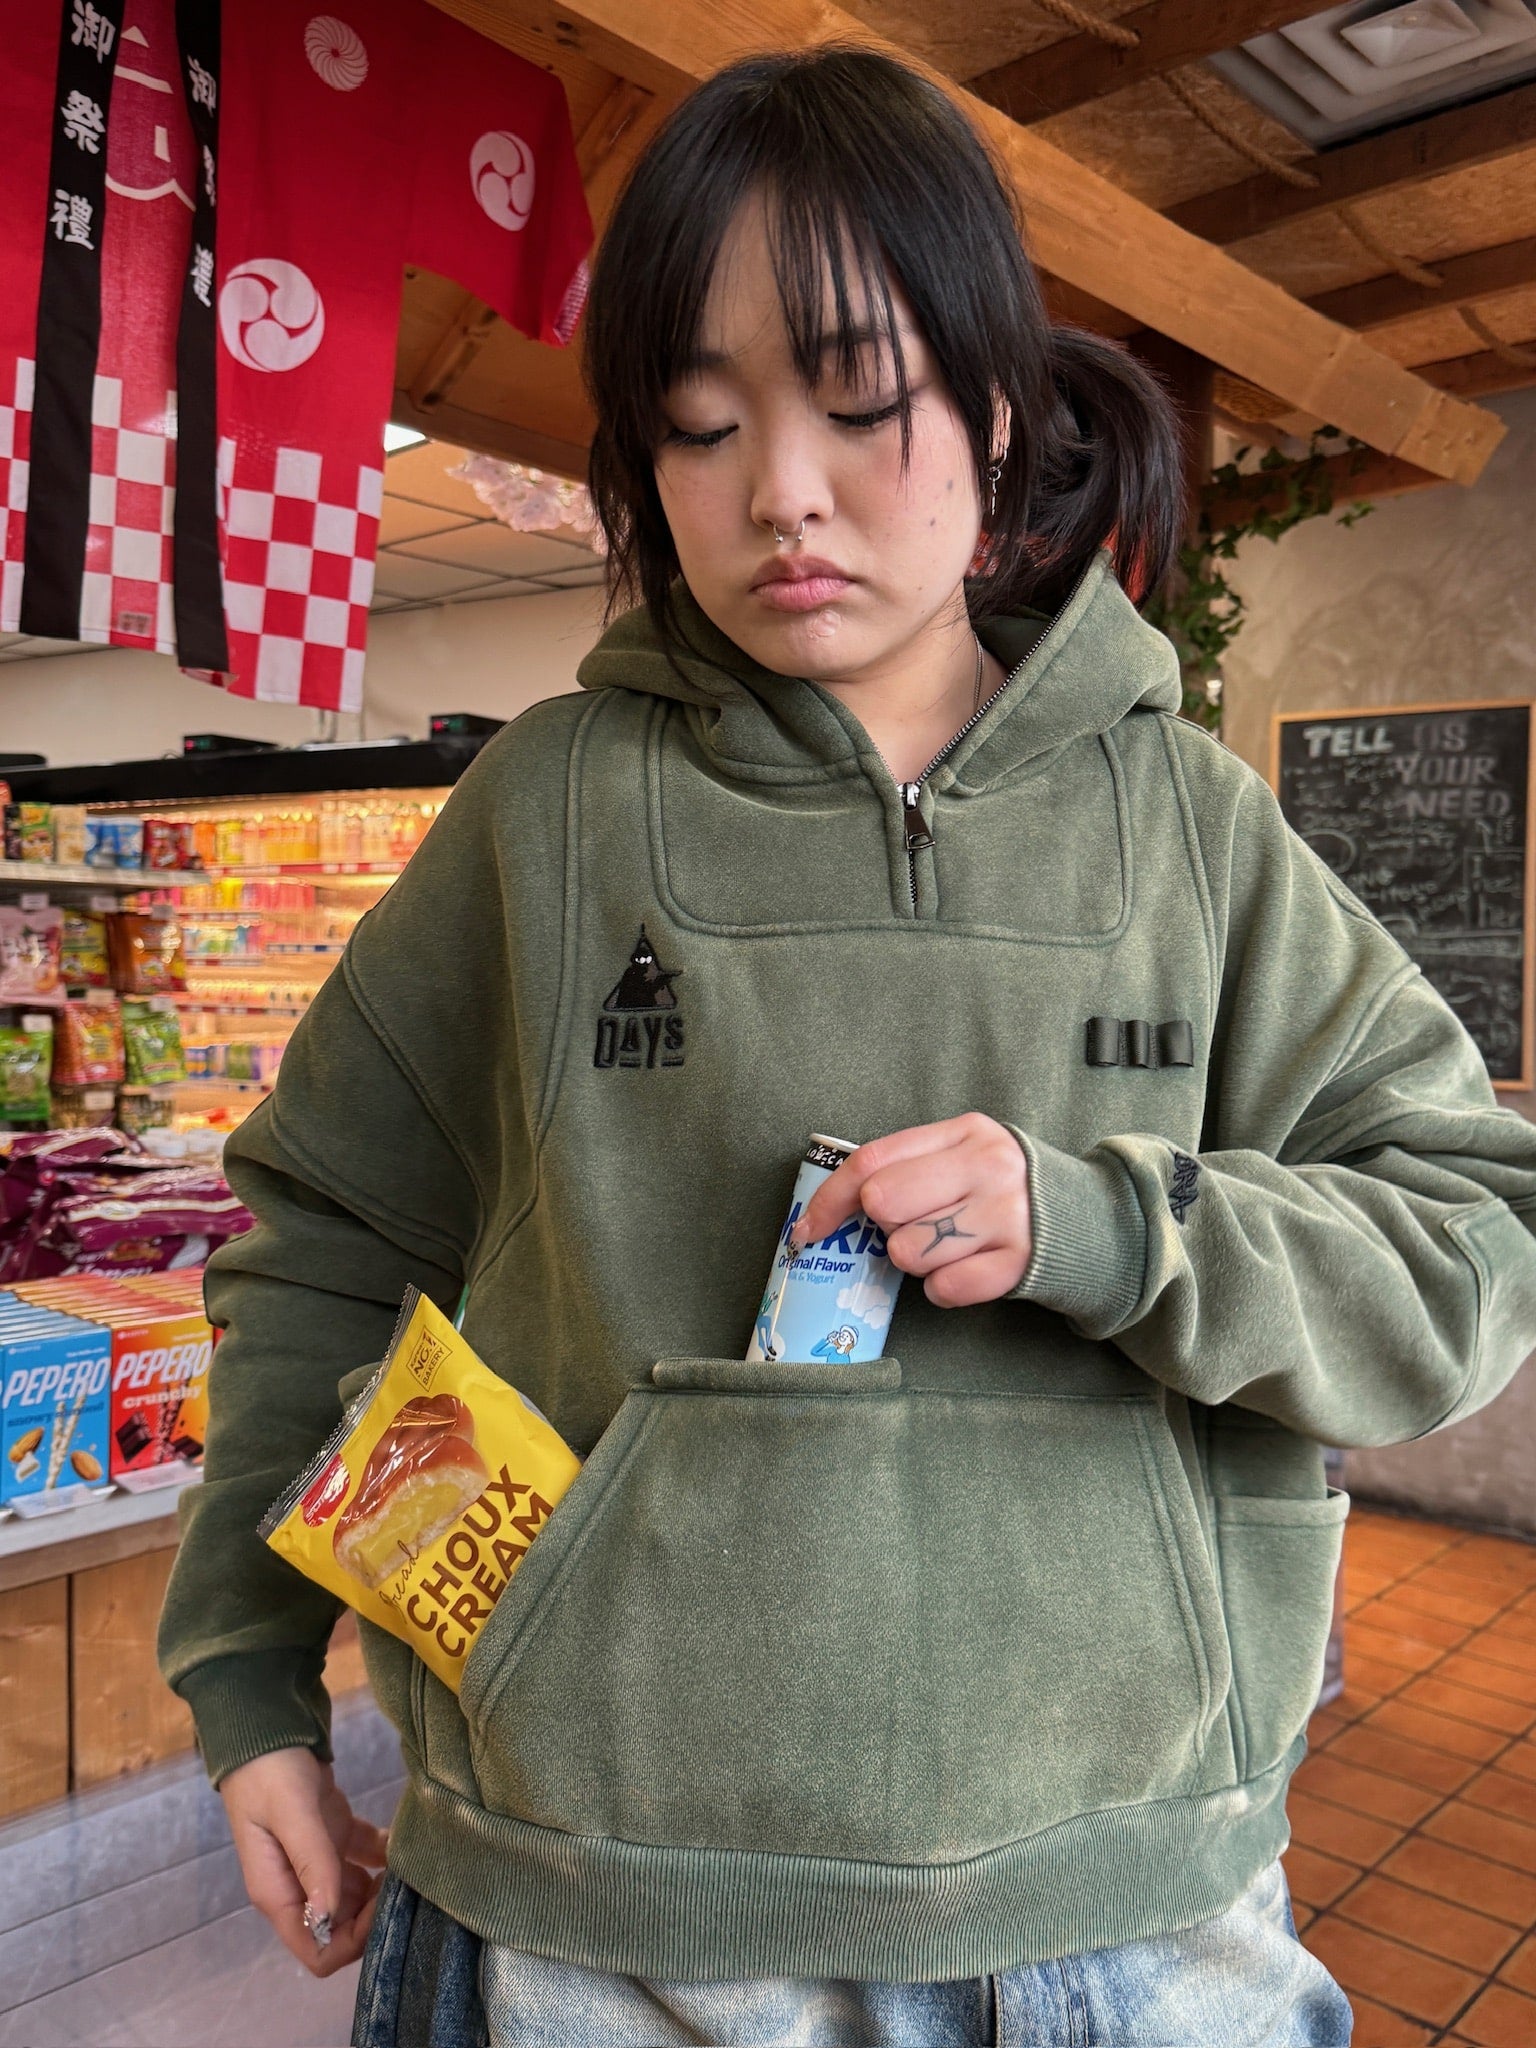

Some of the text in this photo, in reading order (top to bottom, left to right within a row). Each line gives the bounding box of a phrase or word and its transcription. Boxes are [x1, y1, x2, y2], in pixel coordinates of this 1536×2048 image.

[1303, 720, 1468, 758] TELL US
[1394, 751, 1497, 787] YOUR
[1404, 789, 1511, 819] NEED
[593, 1014, 685, 1069] DAYS
[814, 1257, 856, 1273] Flavor
[2, 1356, 112, 1409] PEPERO
[112, 1340, 213, 1392] PEPERO
[422, 1347, 444, 1386] BAKERY
[122, 1385, 202, 1409] crunchy
[407, 1464, 532, 1632] CHOUX
[379, 1540, 420, 1624] bread
[436, 1492, 555, 1658] CREAM
